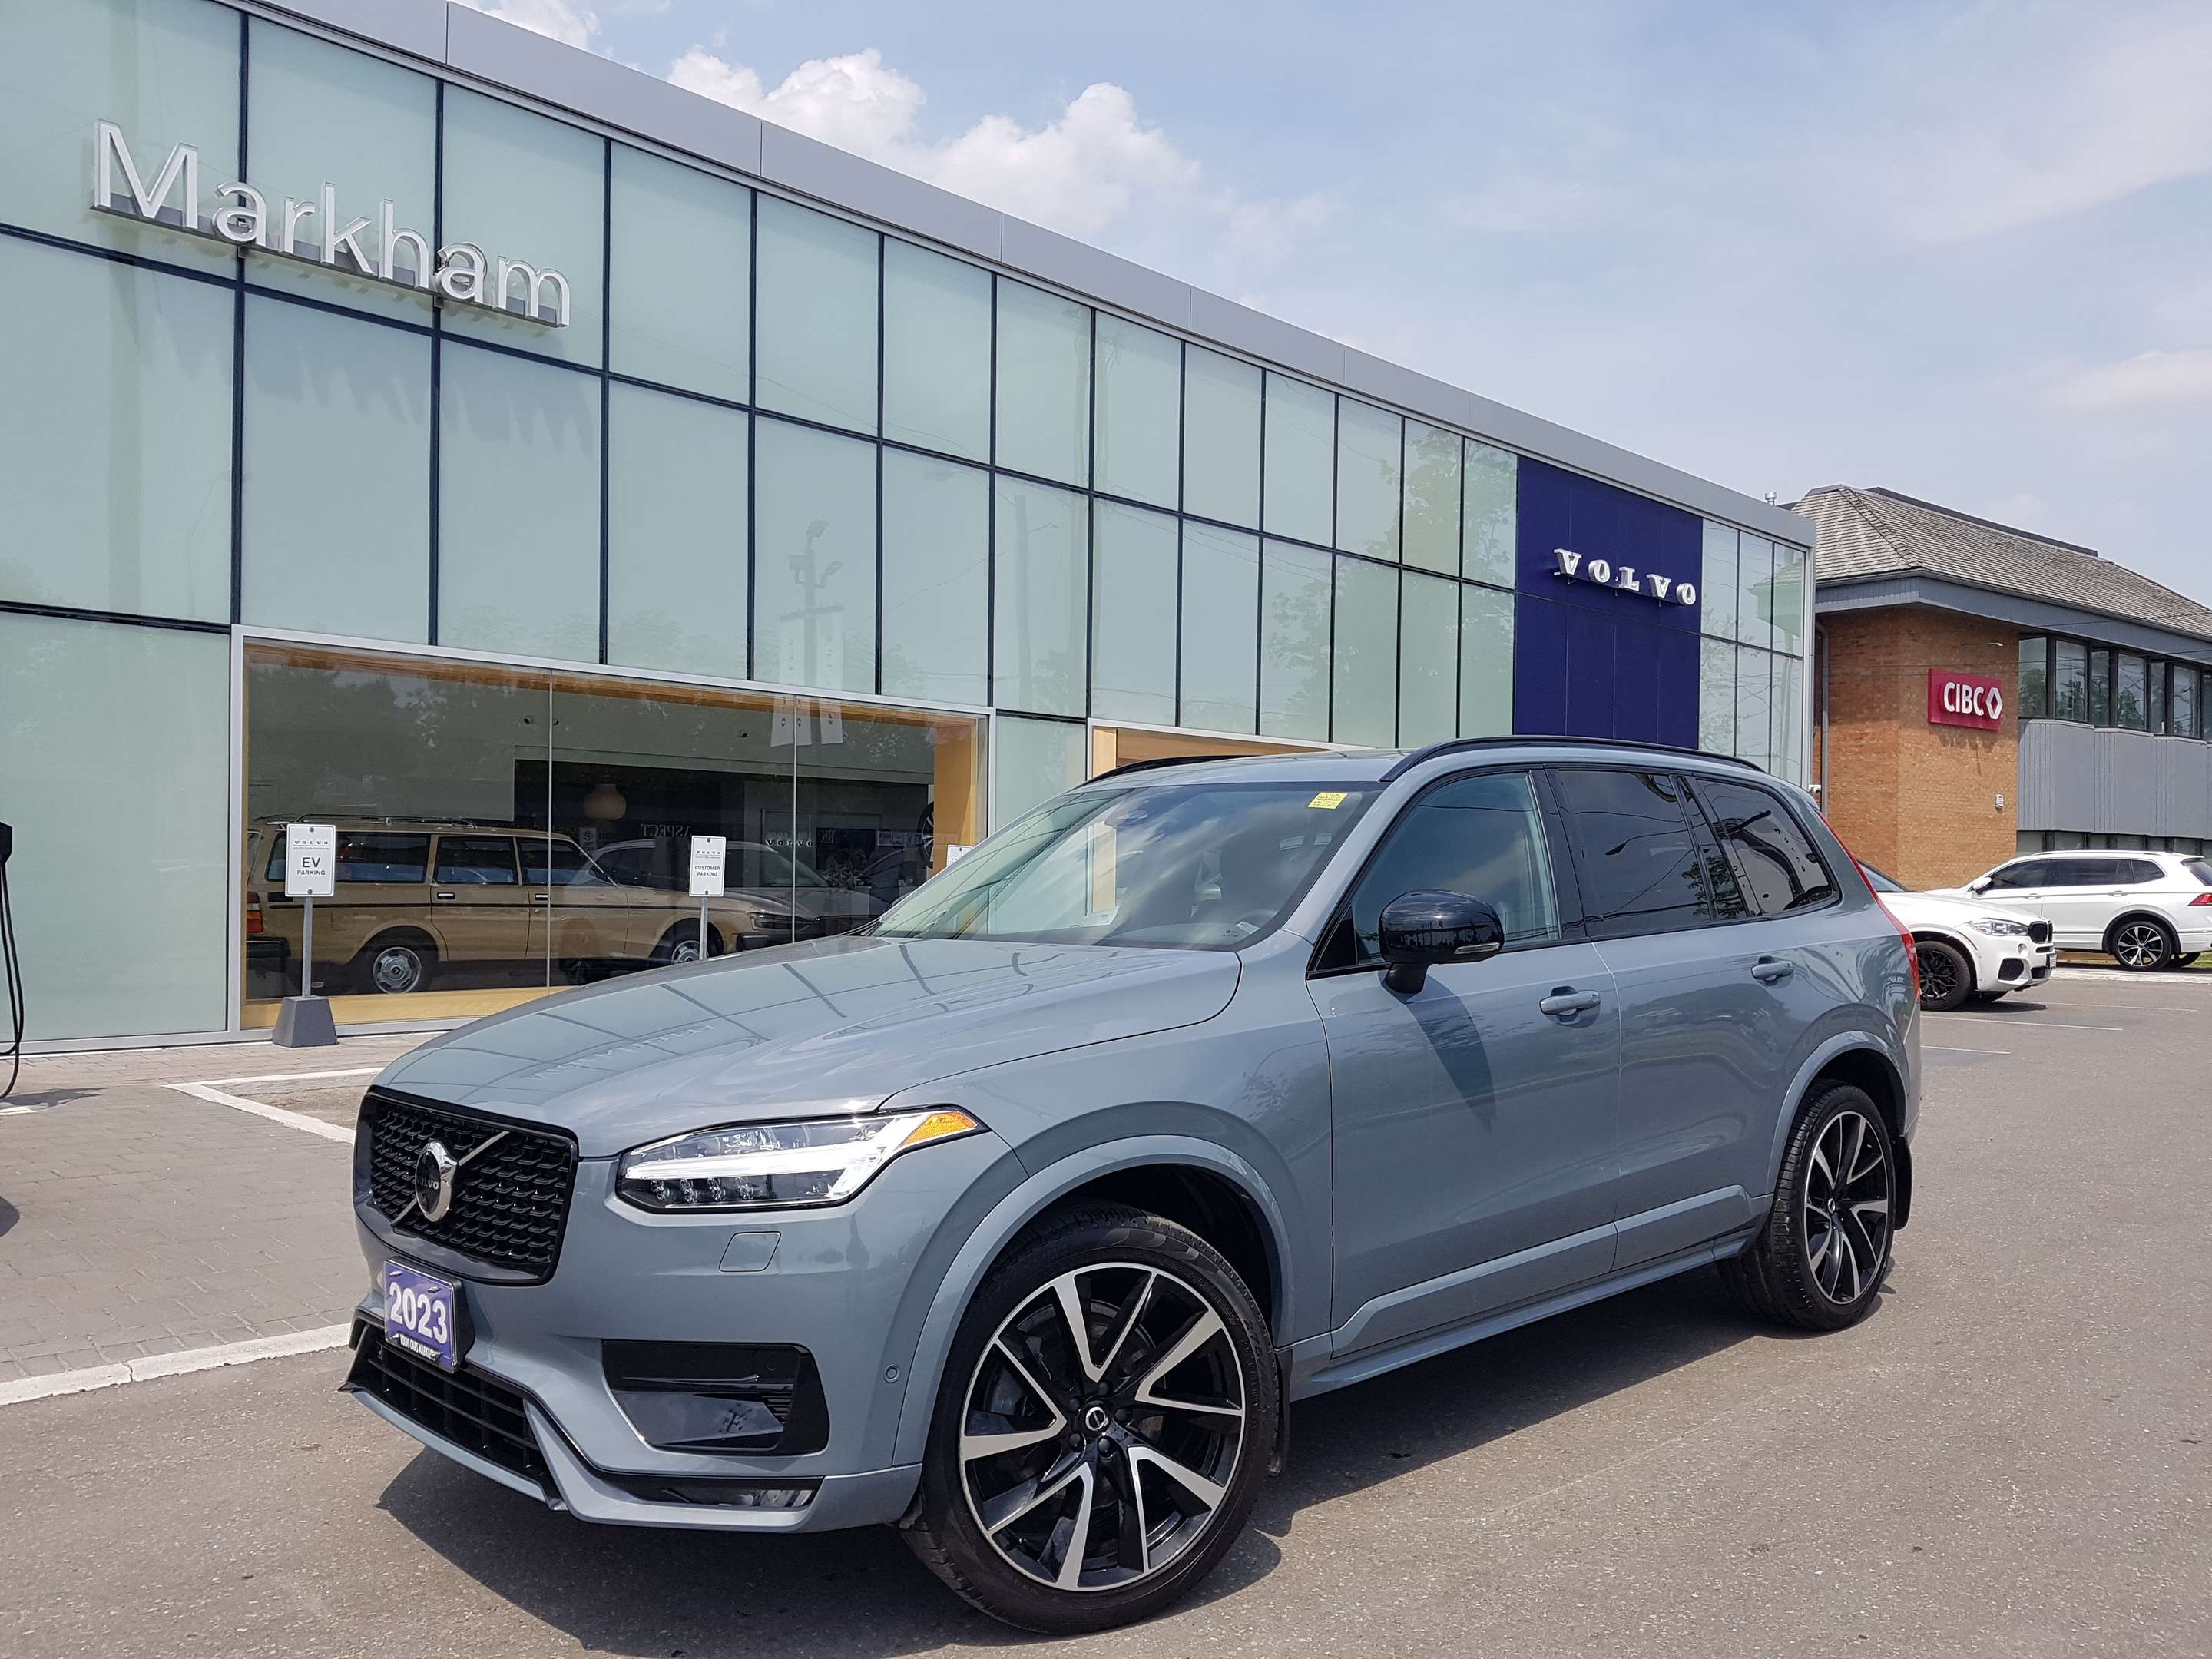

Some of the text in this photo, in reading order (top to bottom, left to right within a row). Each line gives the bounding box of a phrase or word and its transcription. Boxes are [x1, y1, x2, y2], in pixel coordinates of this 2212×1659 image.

[93, 119, 570, 327] Markham
[1554, 548, 1696, 605] VOLVO
[1944, 682, 1985, 716] CIBC
[302, 857, 321, 868] EV
[389, 1282, 448, 1343] 2023
